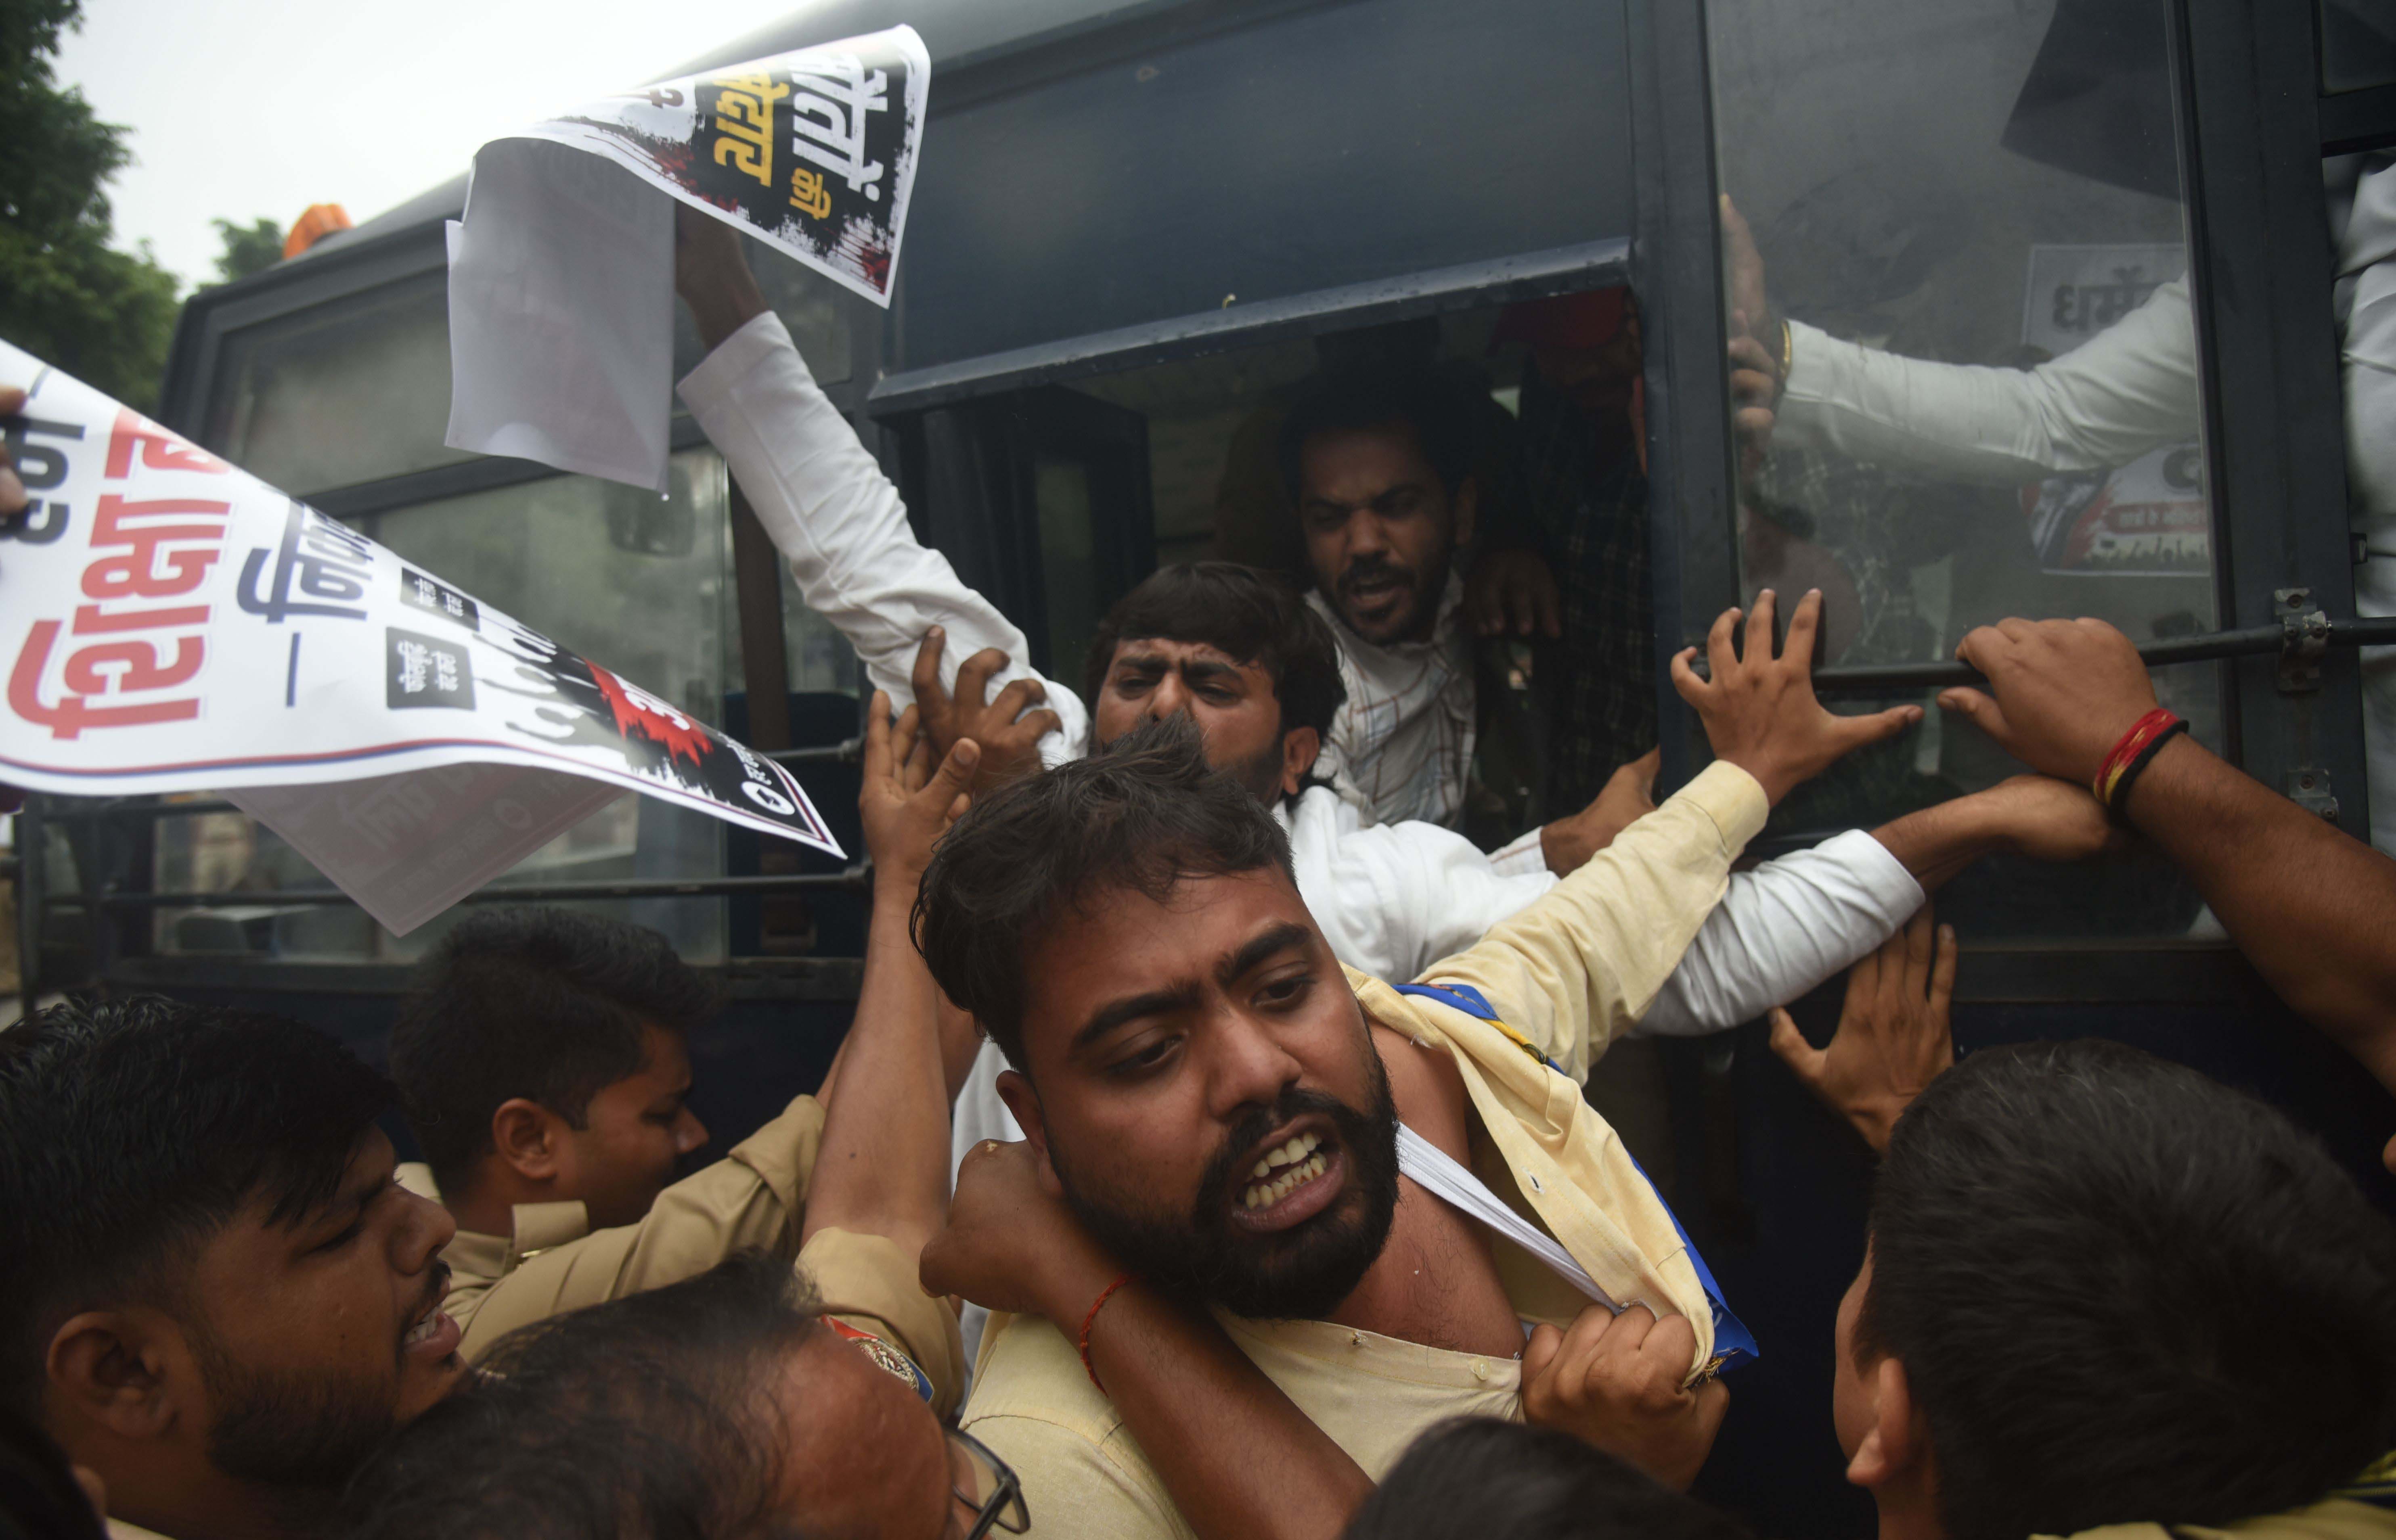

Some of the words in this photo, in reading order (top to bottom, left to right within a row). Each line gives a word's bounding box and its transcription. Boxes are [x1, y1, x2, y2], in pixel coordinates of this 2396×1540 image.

[789, 167, 831, 220] की
[2053, 265, 2161, 332] धर्मे
[7, 494, 232, 741] शिक्षा
